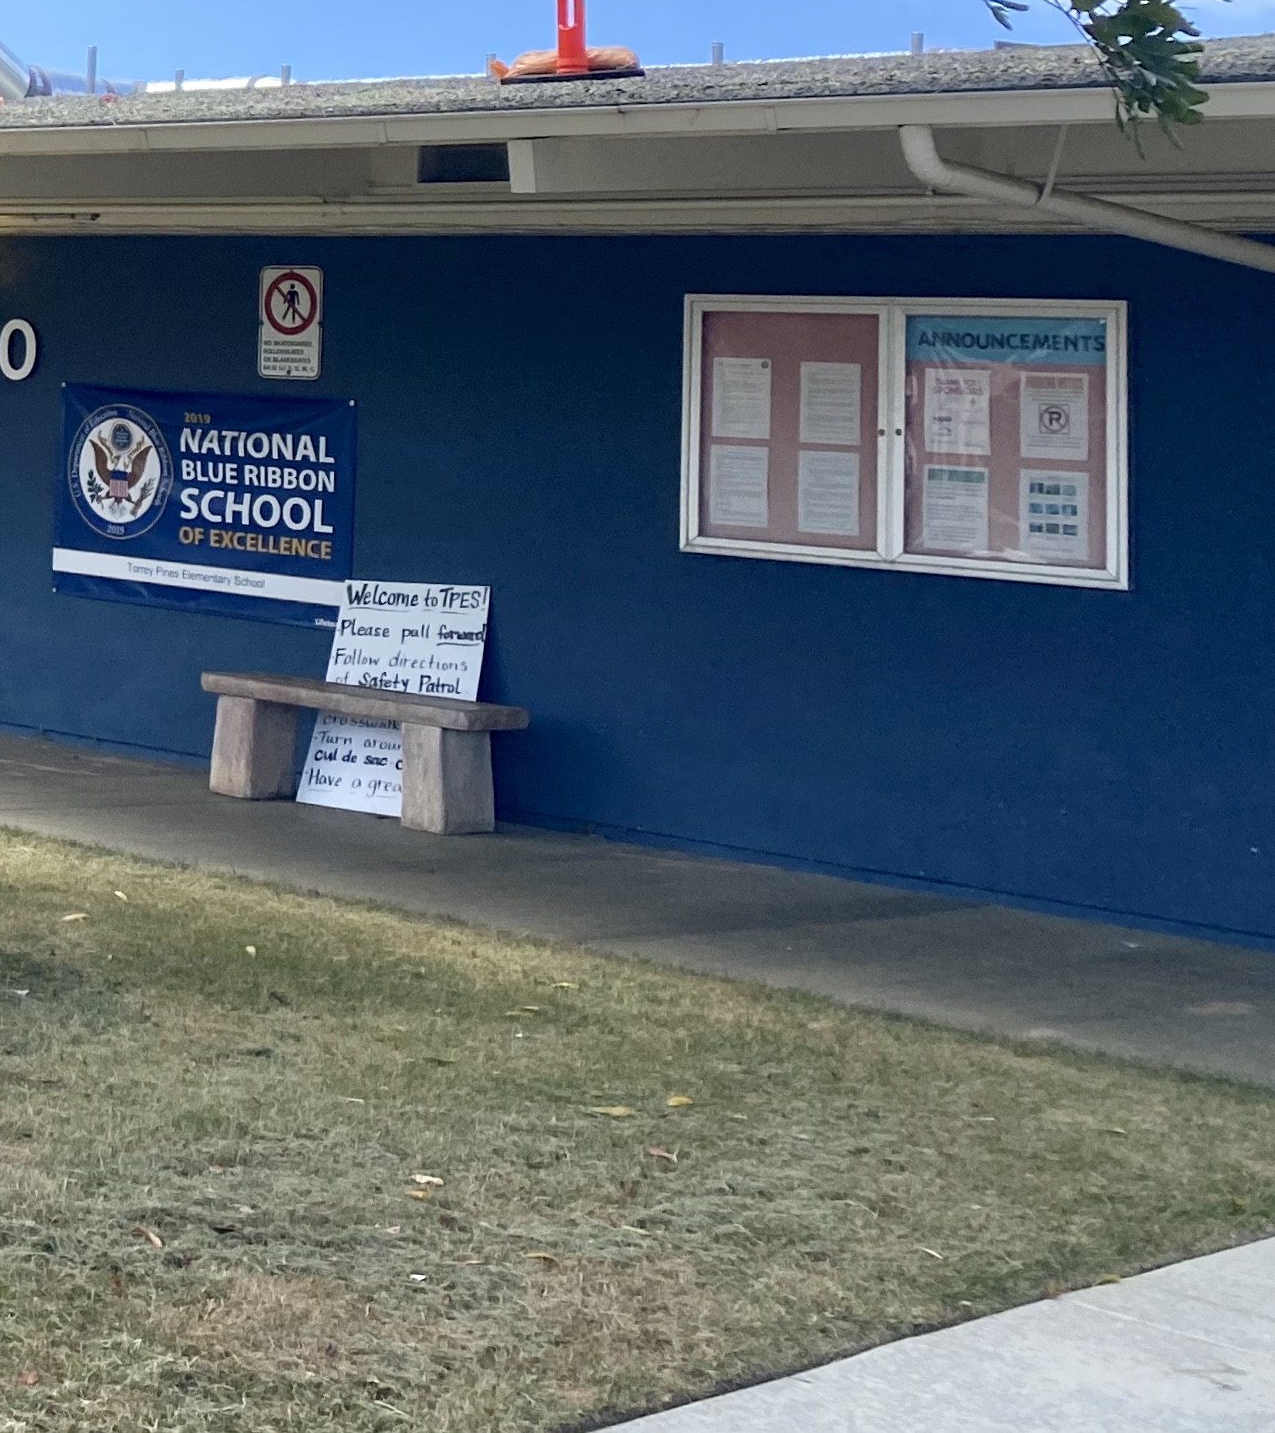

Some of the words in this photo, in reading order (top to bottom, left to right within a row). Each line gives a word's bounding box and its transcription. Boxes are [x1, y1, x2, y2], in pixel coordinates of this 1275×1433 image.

[918, 331, 1106, 352] ANNOUNCEMENTS
[184, 412, 211, 424] 2019
[180, 427, 336, 464] NATIONAL
[182, 459, 238, 485] BLUE
[244, 464, 335, 493] RIBBON
[180, 487, 334, 534] SCHOOL
[179, 526, 204, 545] OF
[209, 529, 332, 560] EXCELLENCE
[128, 562, 154, 577] Torrey
[156, 566, 179, 579] Pines
[182, 569, 232, 586] Elementary
[234, 575, 266, 589] School
[346, 583, 419, 608] Welcome
[424, 588, 439, 607] to
[439, 586, 489, 612] TPES!
[340, 618, 391, 638] Please
[401, 623, 431, 645] pull
[437, 624, 488, 643] forward
[334, 647, 381, 666] Follow
[388, 650, 469, 672] directions
[335, 672, 350, 684] of
[358, 671, 411, 693] Safety
[418, 674, 462, 695] Patrol
[323, 714, 401, 731] crosswalk
[316, 730, 353, 745] Turn
[314, 747, 339, 762] cul
[341, 749, 358, 764] de
[363, 754, 388, 767] sac
[308, 767, 343, 787] Have
[352, 778, 362, 789] a
[365, 779, 402, 798] grea
